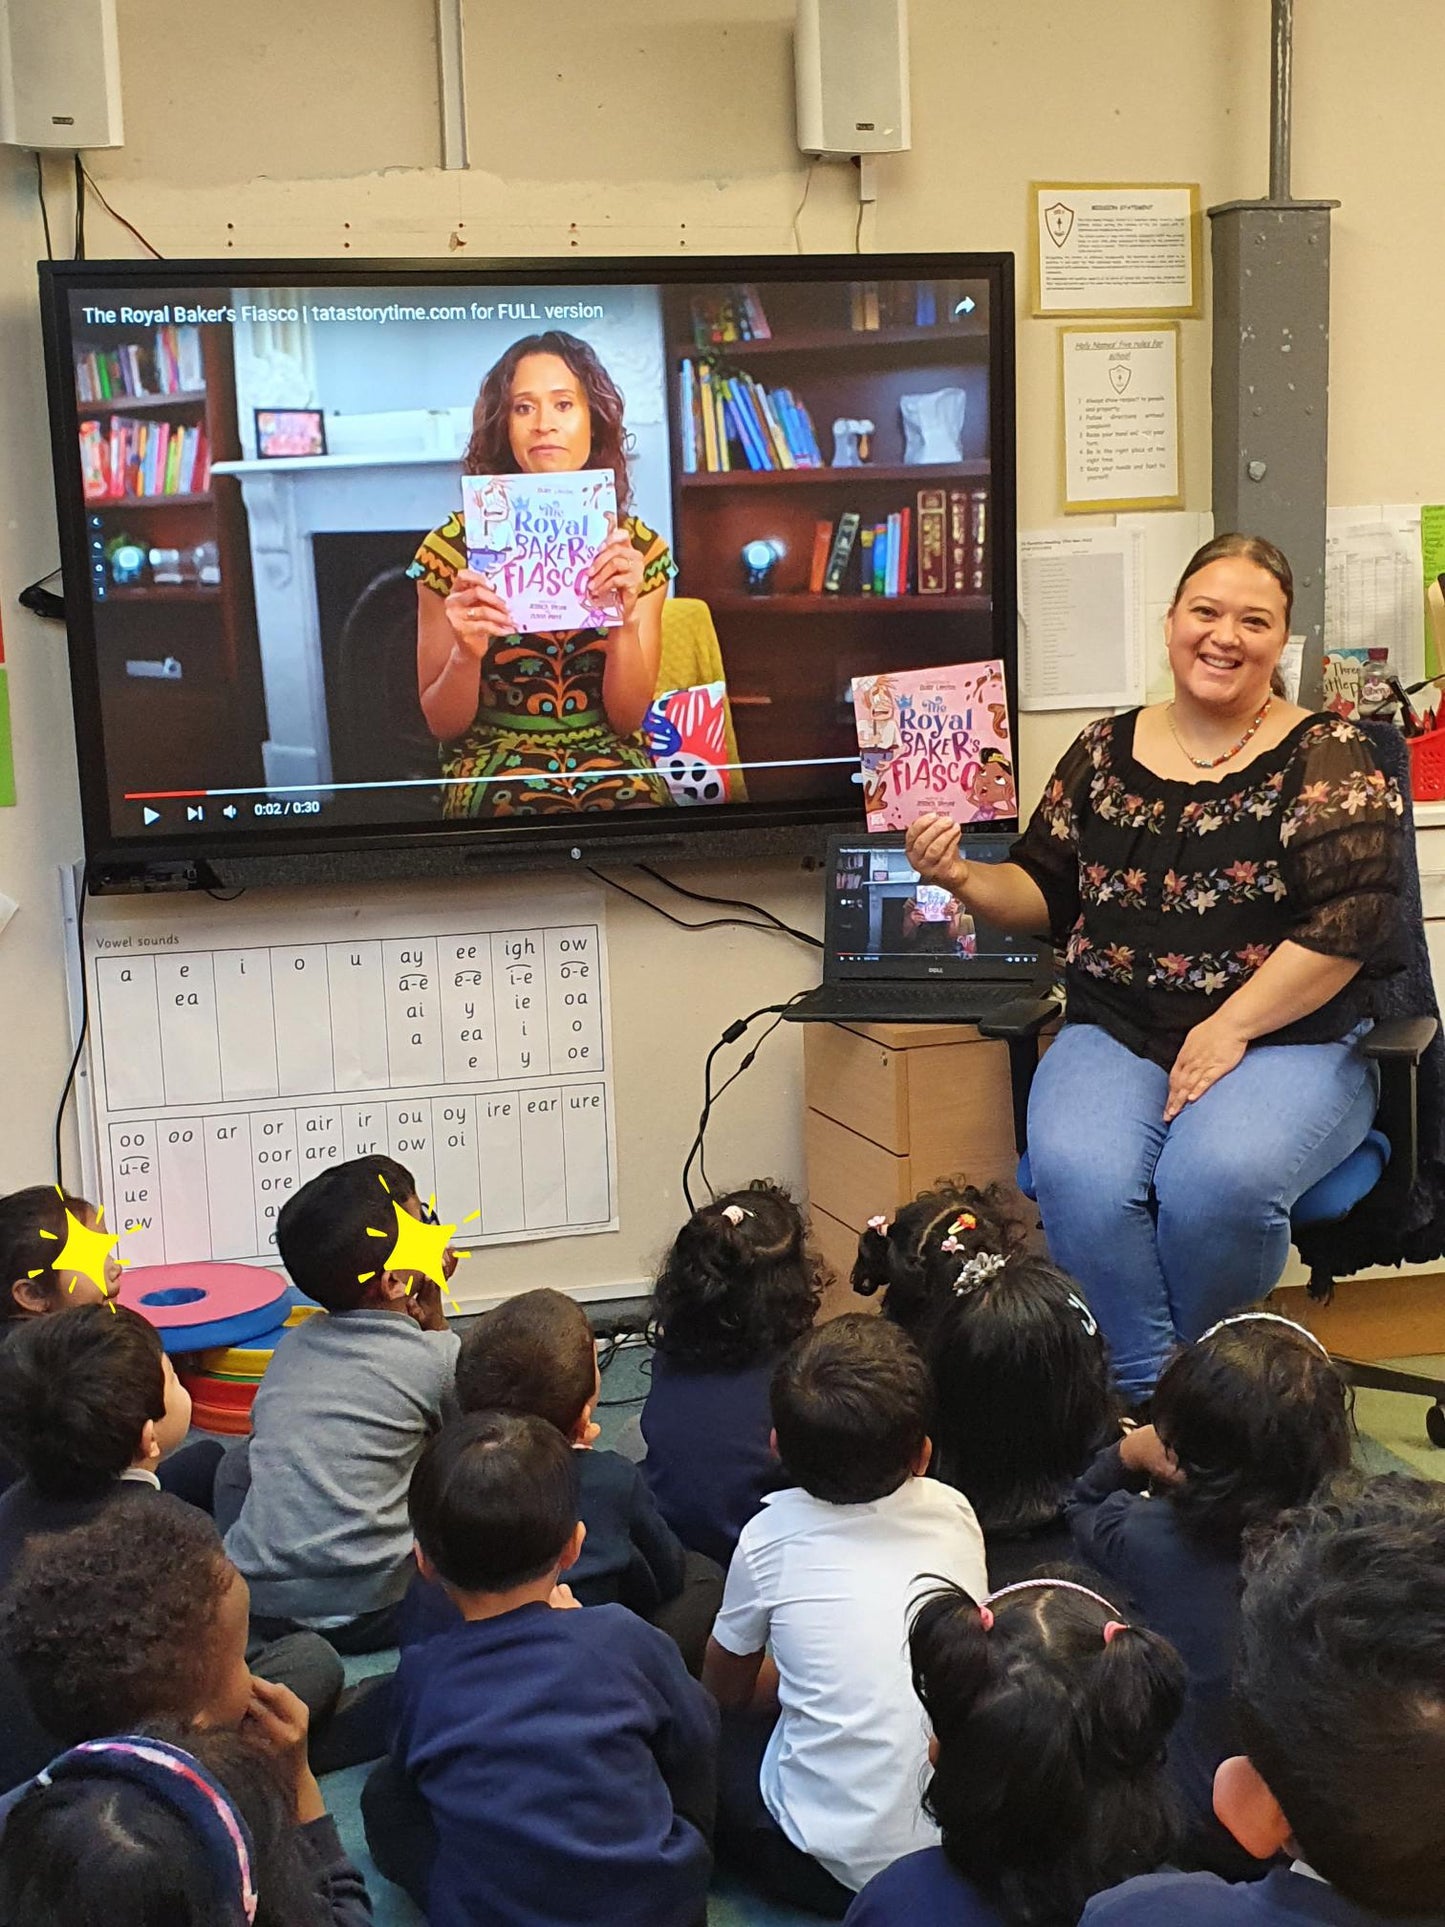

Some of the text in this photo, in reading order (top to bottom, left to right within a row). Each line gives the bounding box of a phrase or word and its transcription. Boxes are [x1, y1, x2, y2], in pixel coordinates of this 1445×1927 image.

[82, 307, 116, 324] The
[120, 306, 169, 327] Royal
[174, 305, 237, 324] Baker's
[242, 306, 299, 322] Fiasco
[311, 304, 466, 325] tatastorytime.com
[470, 303, 494, 319] for
[498, 303, 541, 319] FULL
[544, 302, 604, 319] version
[514, 510, 589, 543] Royal
[921, 695, 947, 713] The
[900, 708, 973, 739] Royal
[254, 802, 282, 817] 0:02
[292, 801, 320, 815] 0:30
[95, 932, 180, 949] Vowel sounds
[559, 939, 587, 952] ow
[456, 946, 477, 960] ee
[505, 937, 535, 960] igh
[240, 958, 246, 975] i
[294, 958, 305, 971] o
[350, 954, 362, 966] u
[400, 951, 423, 968] ay
[120, 969, 132, 982] a
[179, 965, 189, 978] e
[505, 964, 533, 985] i-e
[560, 961, 589, 979] o-e
[399, 974, 429, 992] a-e
[454, 970, 482, 987] e-e
[175, 993, 199, 1006] ea
[515, 994, 531, 1010] ie
[564, 992, 588, 1006] oa
[406, 1002, 424, 1019] ai
[464, 1002, 475, 1020] y
[522, 1021, 527, 1036] i
[572, 1020, 583, 1032] o
[411, 1033, 423, 1045] a
[460, 1028, 483, 1042] ea
[521, 1051, 531, 1069] y
[567, 1046, 589, 1059] oe
[468, 1056, 478, 1068] e
[527, 1099, 558, 1113] ear
[570, 1095, 600, 1109] ure
[443, 1108, 466, 1125] oy
[487, 1102, 511, 1118] ire
[306, 1115, 334, 1132] air
[358, 1113, 372, 1128] ir
[398, 1111, 423, 1125] ou
[216, 1126, 238, 1140] ar
[263, 1122, 284, 1136] or
[119, 1134, 145, 1148] oo
[168, 1130, 194, 1144] oo
[447, 1131, 465, 1148] oi
[305, 1145, 337, 1160] are
[357, 1142, 377, 1155] ur
[397, 1138, 426, 1152] ow
[258, 1149, 292, 1164] oor
[119, 1156, 150, 1176] u-e
[261, 1177, 293, 1191] ore
[125, 1189, 148, 1203] ue
[124, 1217, 153, 1231] ew
